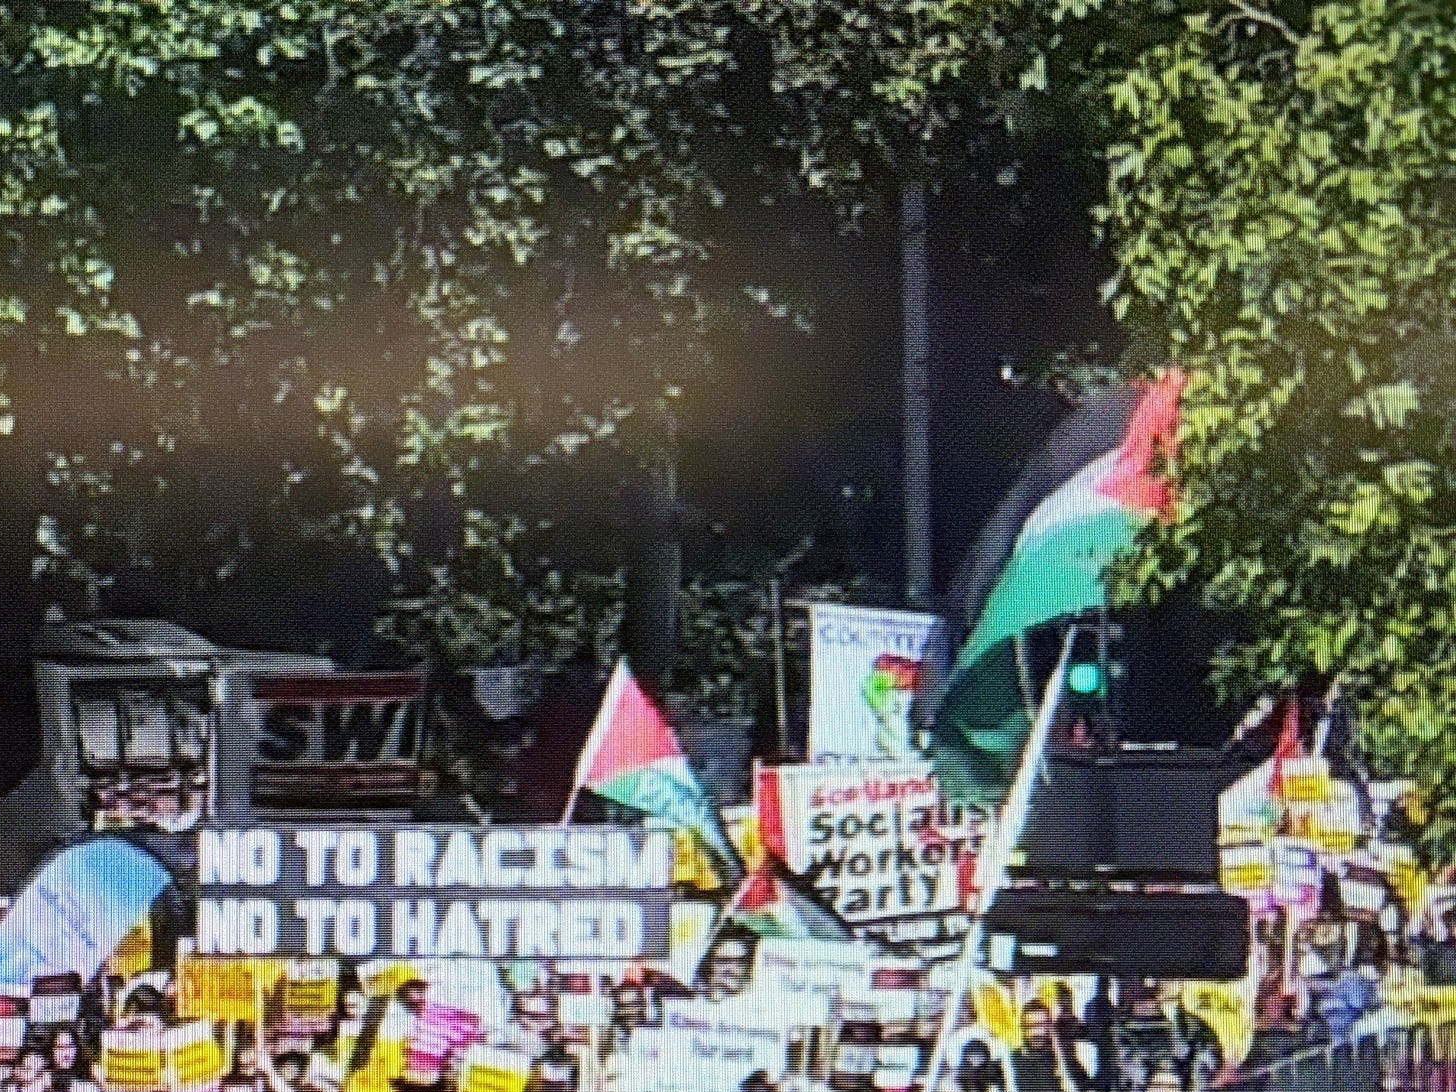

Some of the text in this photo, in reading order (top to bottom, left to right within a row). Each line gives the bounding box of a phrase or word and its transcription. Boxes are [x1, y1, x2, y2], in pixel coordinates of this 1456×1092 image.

[197, 829, 669, 888] NO TO RACISM
[197, 900, 644, 957] NO TO HATRED
